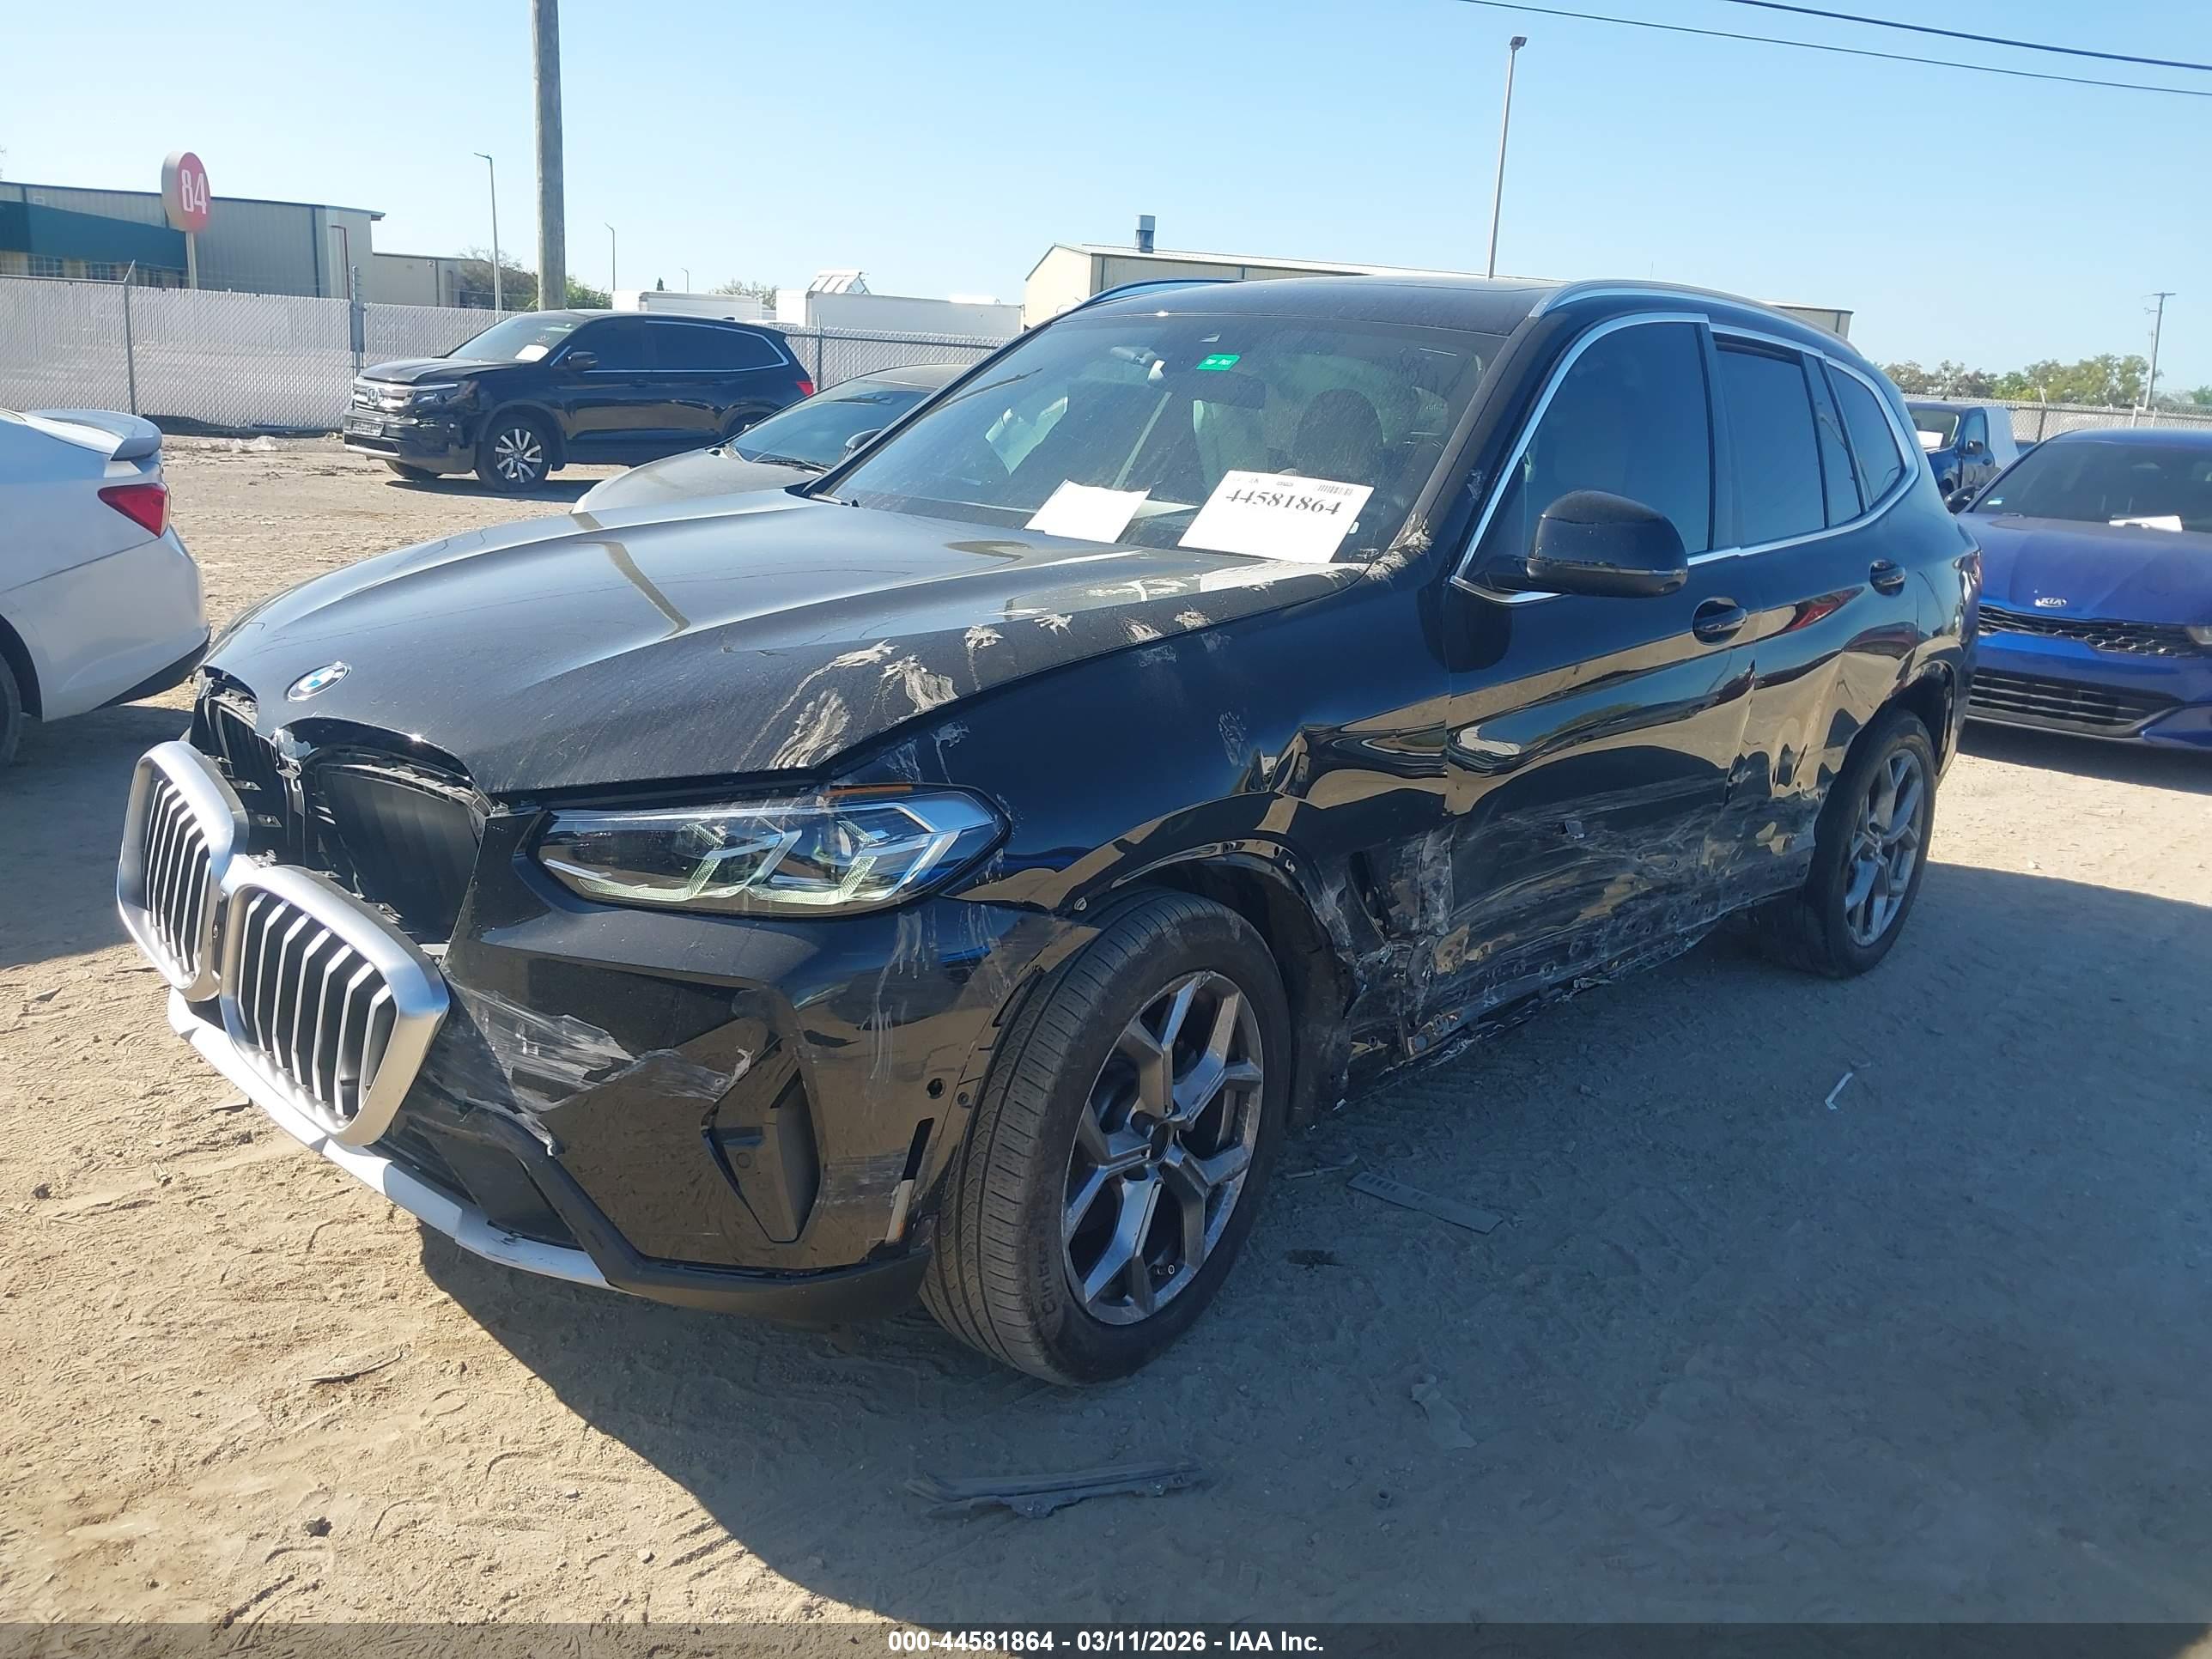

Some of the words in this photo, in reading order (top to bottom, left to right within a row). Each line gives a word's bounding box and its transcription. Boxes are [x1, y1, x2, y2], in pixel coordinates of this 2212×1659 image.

[181, 169, 207, 215] 84
[1225, 489, 1342, 515] 44581864
[2039, 598, 2064, 607] KIA
